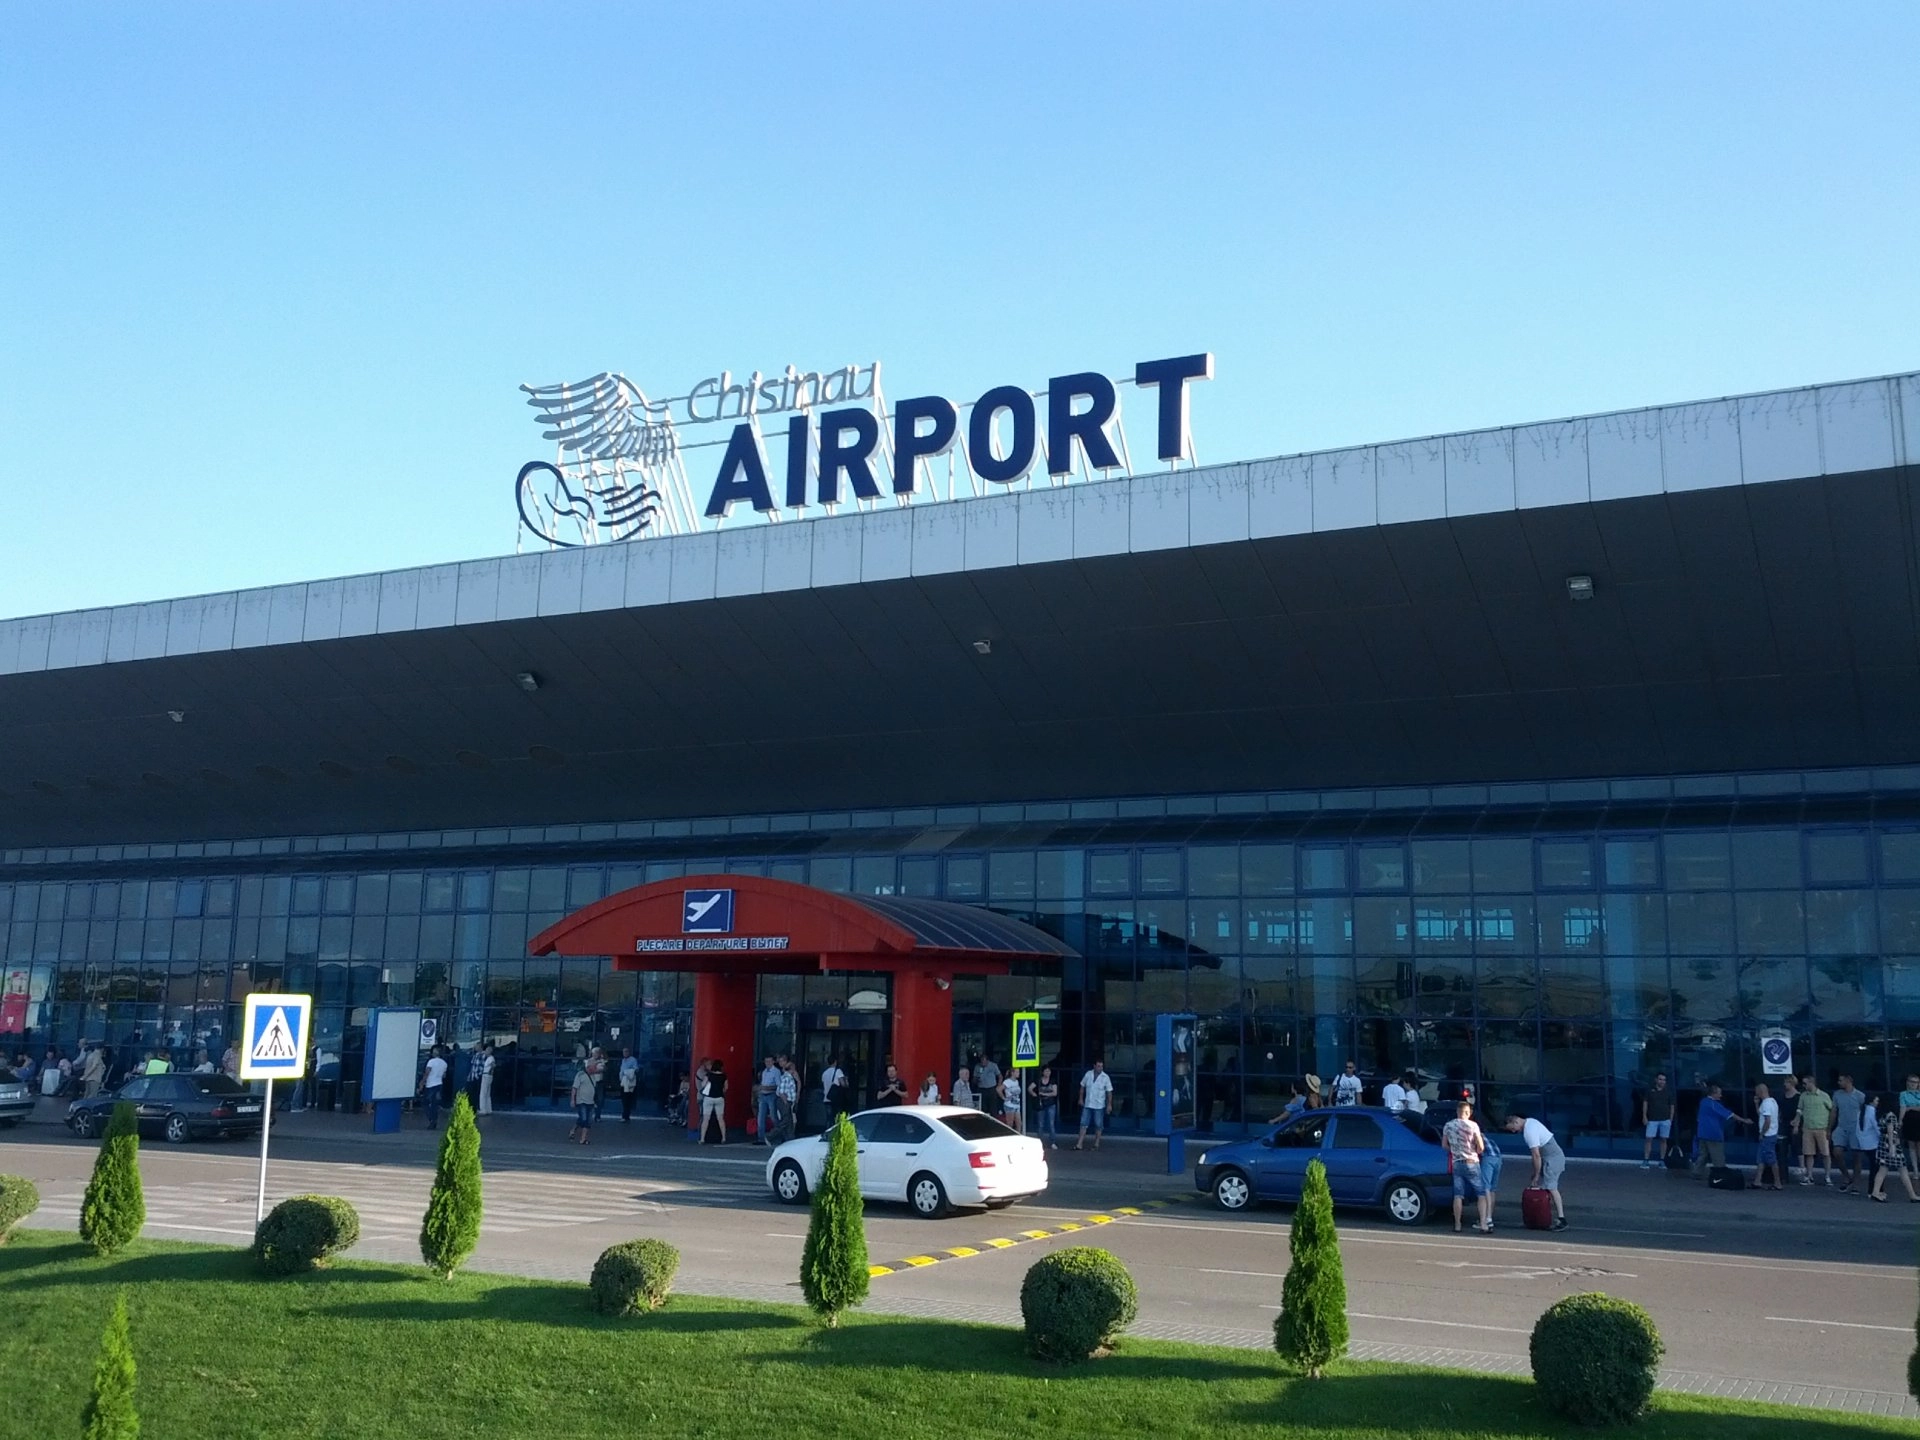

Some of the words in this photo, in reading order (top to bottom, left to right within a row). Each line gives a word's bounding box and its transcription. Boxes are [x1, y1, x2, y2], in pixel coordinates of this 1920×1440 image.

[687, 360, 881, 423] Chisinau
[704, 353, 1214, 517] AIRPORT
[636, 939, 684, 952] PLECARE
[686, 938, 748, 951] DEPARTURE
[750, 937, 789, 950] ВЫЛЕТ
